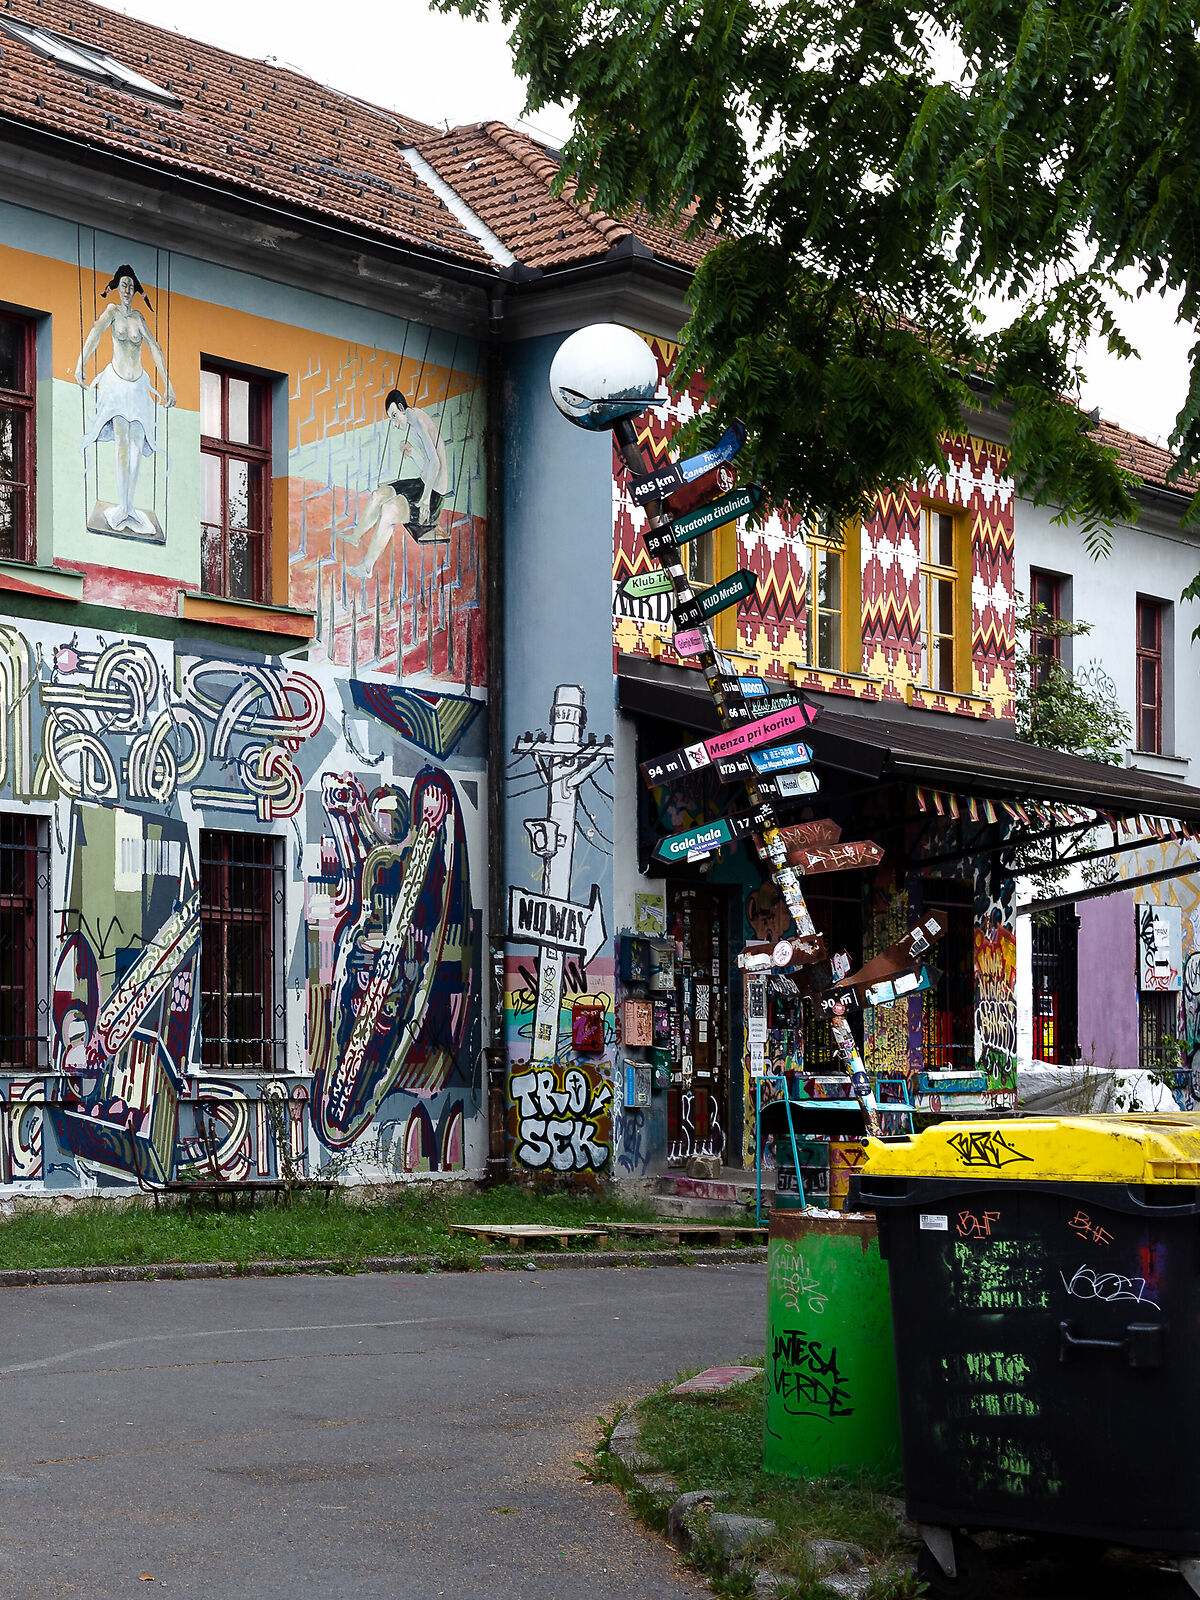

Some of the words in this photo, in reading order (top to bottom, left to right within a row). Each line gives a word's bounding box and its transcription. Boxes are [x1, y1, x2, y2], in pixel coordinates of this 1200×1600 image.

[635, 480, 656, 497] 485
[655, 475, 675, 489] km
[674, 512, 713, 537] Škratova
[713, 495, 750, 519] čitalnica
[648, 537, 660, 550] 58
[662, 534, 672, 543] m
[632, 574, 655, 588] Klub
[702, 594, 719, 610] KUD
[720, 581, 743, 599] Mreža
[678, 612, 688, 624] 30
[690, 608, 698, 618] m
[729, 707, 738, 718] 66
[739, 708, 747, 716] m
[710, 735, 745, 754] Menza
[747, 726, 762, 743] pri
[763, 715, 796, 734] koritu
[648, 767, 664, 779] 94
[666, 762, 678, 772] m
[720, 765, 736, 775] 8729
[736, 762, 749, 771] km
[758, 784, 769, 793] 112
[737, 818, 750, 830] 17
[754, 814, 764, 824] m
[669, 836, 696, 853] Gala
[697, 828, 722, 843] hala
[821, 998, 835, 1011] 90
